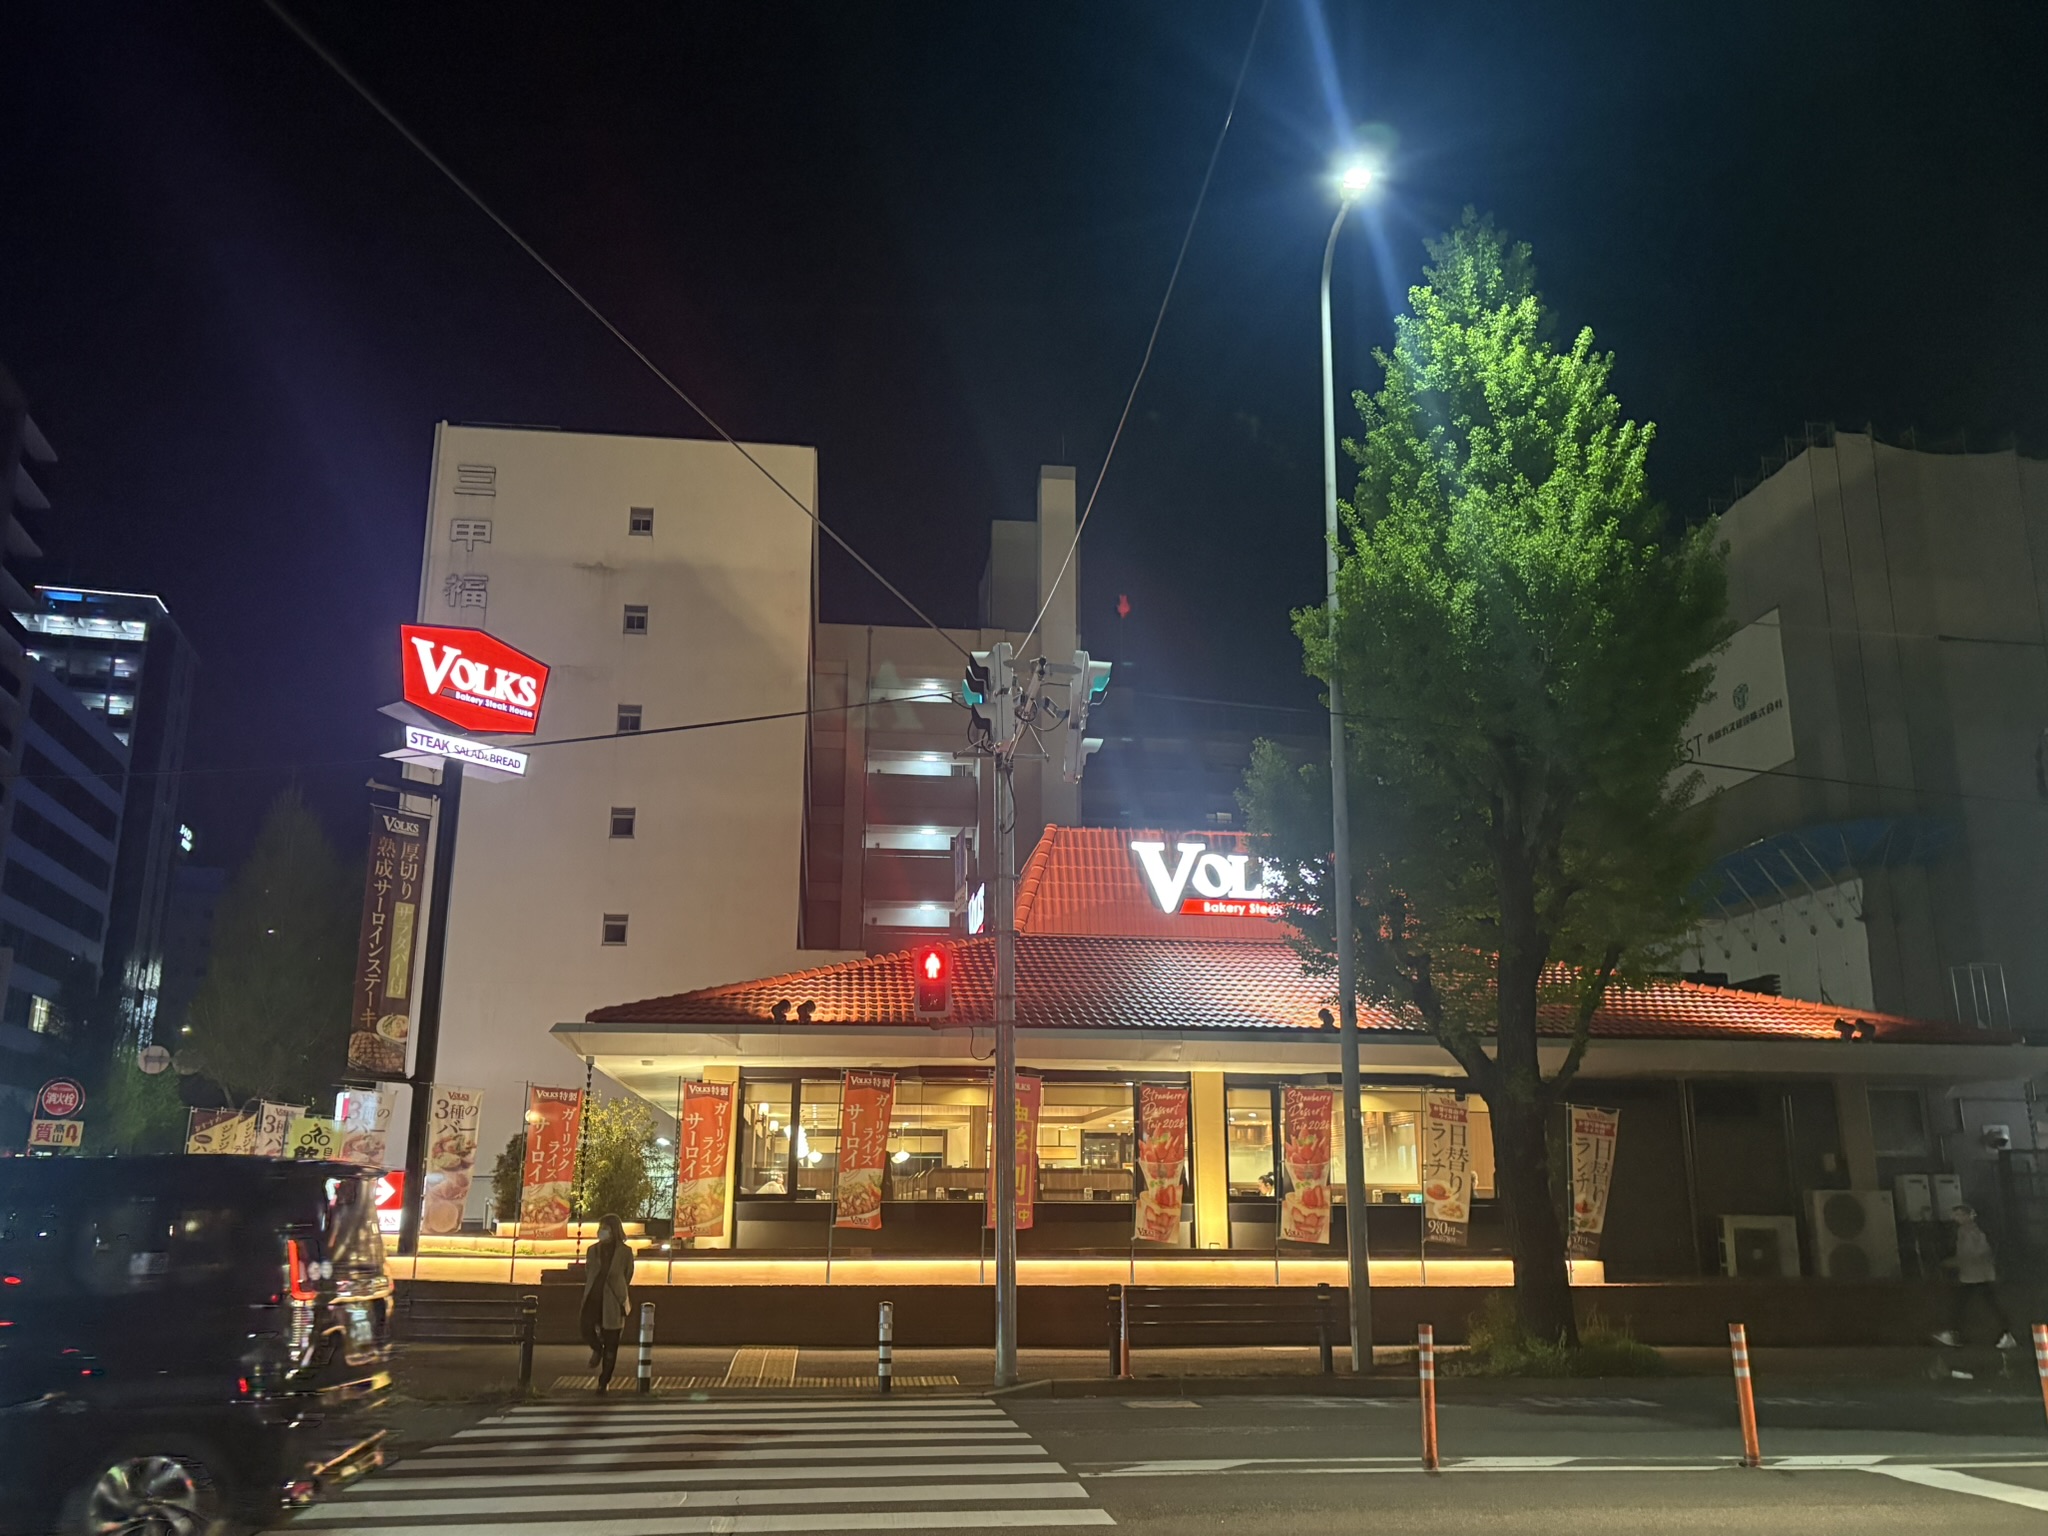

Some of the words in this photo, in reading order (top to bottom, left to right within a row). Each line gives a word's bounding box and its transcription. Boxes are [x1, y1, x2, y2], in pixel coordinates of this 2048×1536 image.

[411, 636, 537, 707] VOLKS
[455, 691, 484, 706] Bakery
[485, 699, 508, 712] Steak
[509, 703, 533, 718] House
[410, 731, 451, 753] STEAK
[382, 814, 420, 835] VOLKS
[399, 842, 421, 900] 厚切り
[1203, 901, 1245, 916] Bakery
[359, 836, 397, 1028] 熟成サーロインステーキ
[46, 1092, 75, 1106] 消火栓
[434, 1099, 479, 1120] 3種の
[1141, 1088, 1186, 1105] Strawberry
[1143, 1101, 1180, 1116] Dessert
[1285, 1090, 1331, 1106] Strawberry
[1288, 1105, 1327, 1118] Dessert
[34, 1123, 53, 1142] 質
[436, 1120, 476, 1135] バー
[558, 1107, 578, 1172] ガーリック
[712, 1101, 729, 1168] ガーリック
[844, 1103, 864, 1182] サーロイン
[872, 1093, 890, 1160] ガーリック
[1144, 1116, 1162, 1131] Fair
[1291, 1117, 1307, 1132] Fair
[528, 1116, 550, 1197] サーロイン
[545, 1140, 562, 1180] ライス
[682, 1112, 705, 1193] サーロイン
[698, 1136, 714, 1176] ライス
[860, 1127, 874, 1167] ライス
[1428, 1121, 1446, 1178] ランチ
[1446, 1123, 1470, 1196] 日替り
[1575, 1136, 1591, 1193] ランチ
